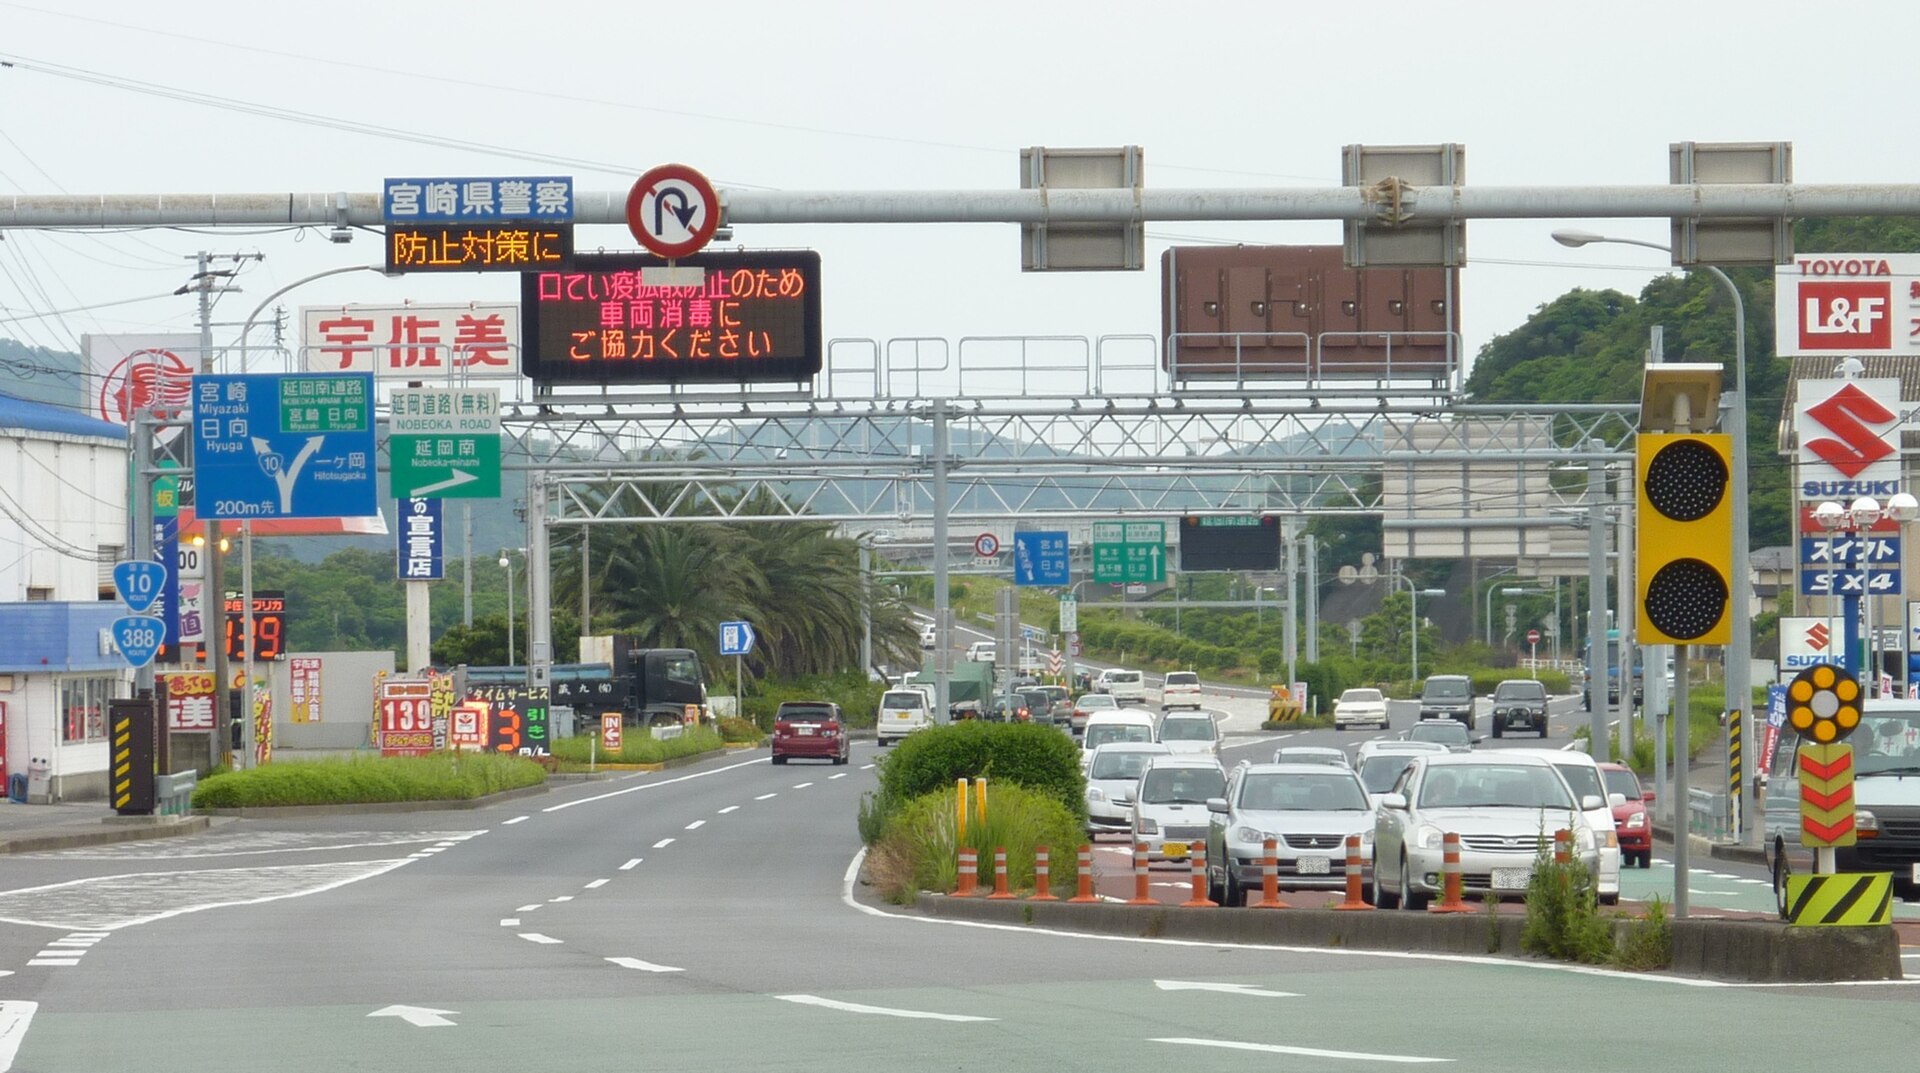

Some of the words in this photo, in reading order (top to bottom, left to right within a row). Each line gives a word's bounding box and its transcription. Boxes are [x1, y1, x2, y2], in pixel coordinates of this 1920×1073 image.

[388, 181, 569, 214] 宮崎県警察
[394, 230, 561, 265] 防止対策に
[1798, 260, 1891, 276] TOYOTA
[600, 300, 741, 329] 車両消毒に
[1806, 297, 1884, 333] L&F
[319, 314, 509, 369] 宇佐美
[570, 329, 771, 360] ご協力ください
[200, 382, 247, 402] 宮崎
[283, 380, 362, 395] 延岡南道路
[200, 403, 249, 416] Miyazaki
[392, 392, 498, 415] 延岡道路(無料)
[289, 408, 319, 421] 宮崎
[328, 408, 357, 421] 日向
[202, 418, 247, 438] 日向
[397, 419, 452, 430] NOBEOKA
[460, 419, 491, 429] ROAD
[207, 440, 243, 452] Hyuga
[415, 439, 475, 456] 延岡南
[264, 457, 278, 470] 10
[411, 458, 480, 467] Nobeoka-minami
[314, 471, 366, 482] Hitotsugaoka
[1803, 480, 1899, 496] SUZUKI
[216, 500, 274, 515] 200m先
[407, 498, 435, 577] の宣言店
[1810, 540, 1895, 560] スイフト
[127, 574, 151, 593] 10
[1810, 573, 1895, 590] SX4
[224, 601, 282, 611] 宇佐プリカ
[122, 629, 154, 647] 388
[473, 687, 548, 700] タイムサービス
[384, 700, 431, 730] 139
[605, 717, 618, 728] IN
[497, 710, 520, 751] 3
[527, 708, 545, 740] 引き
